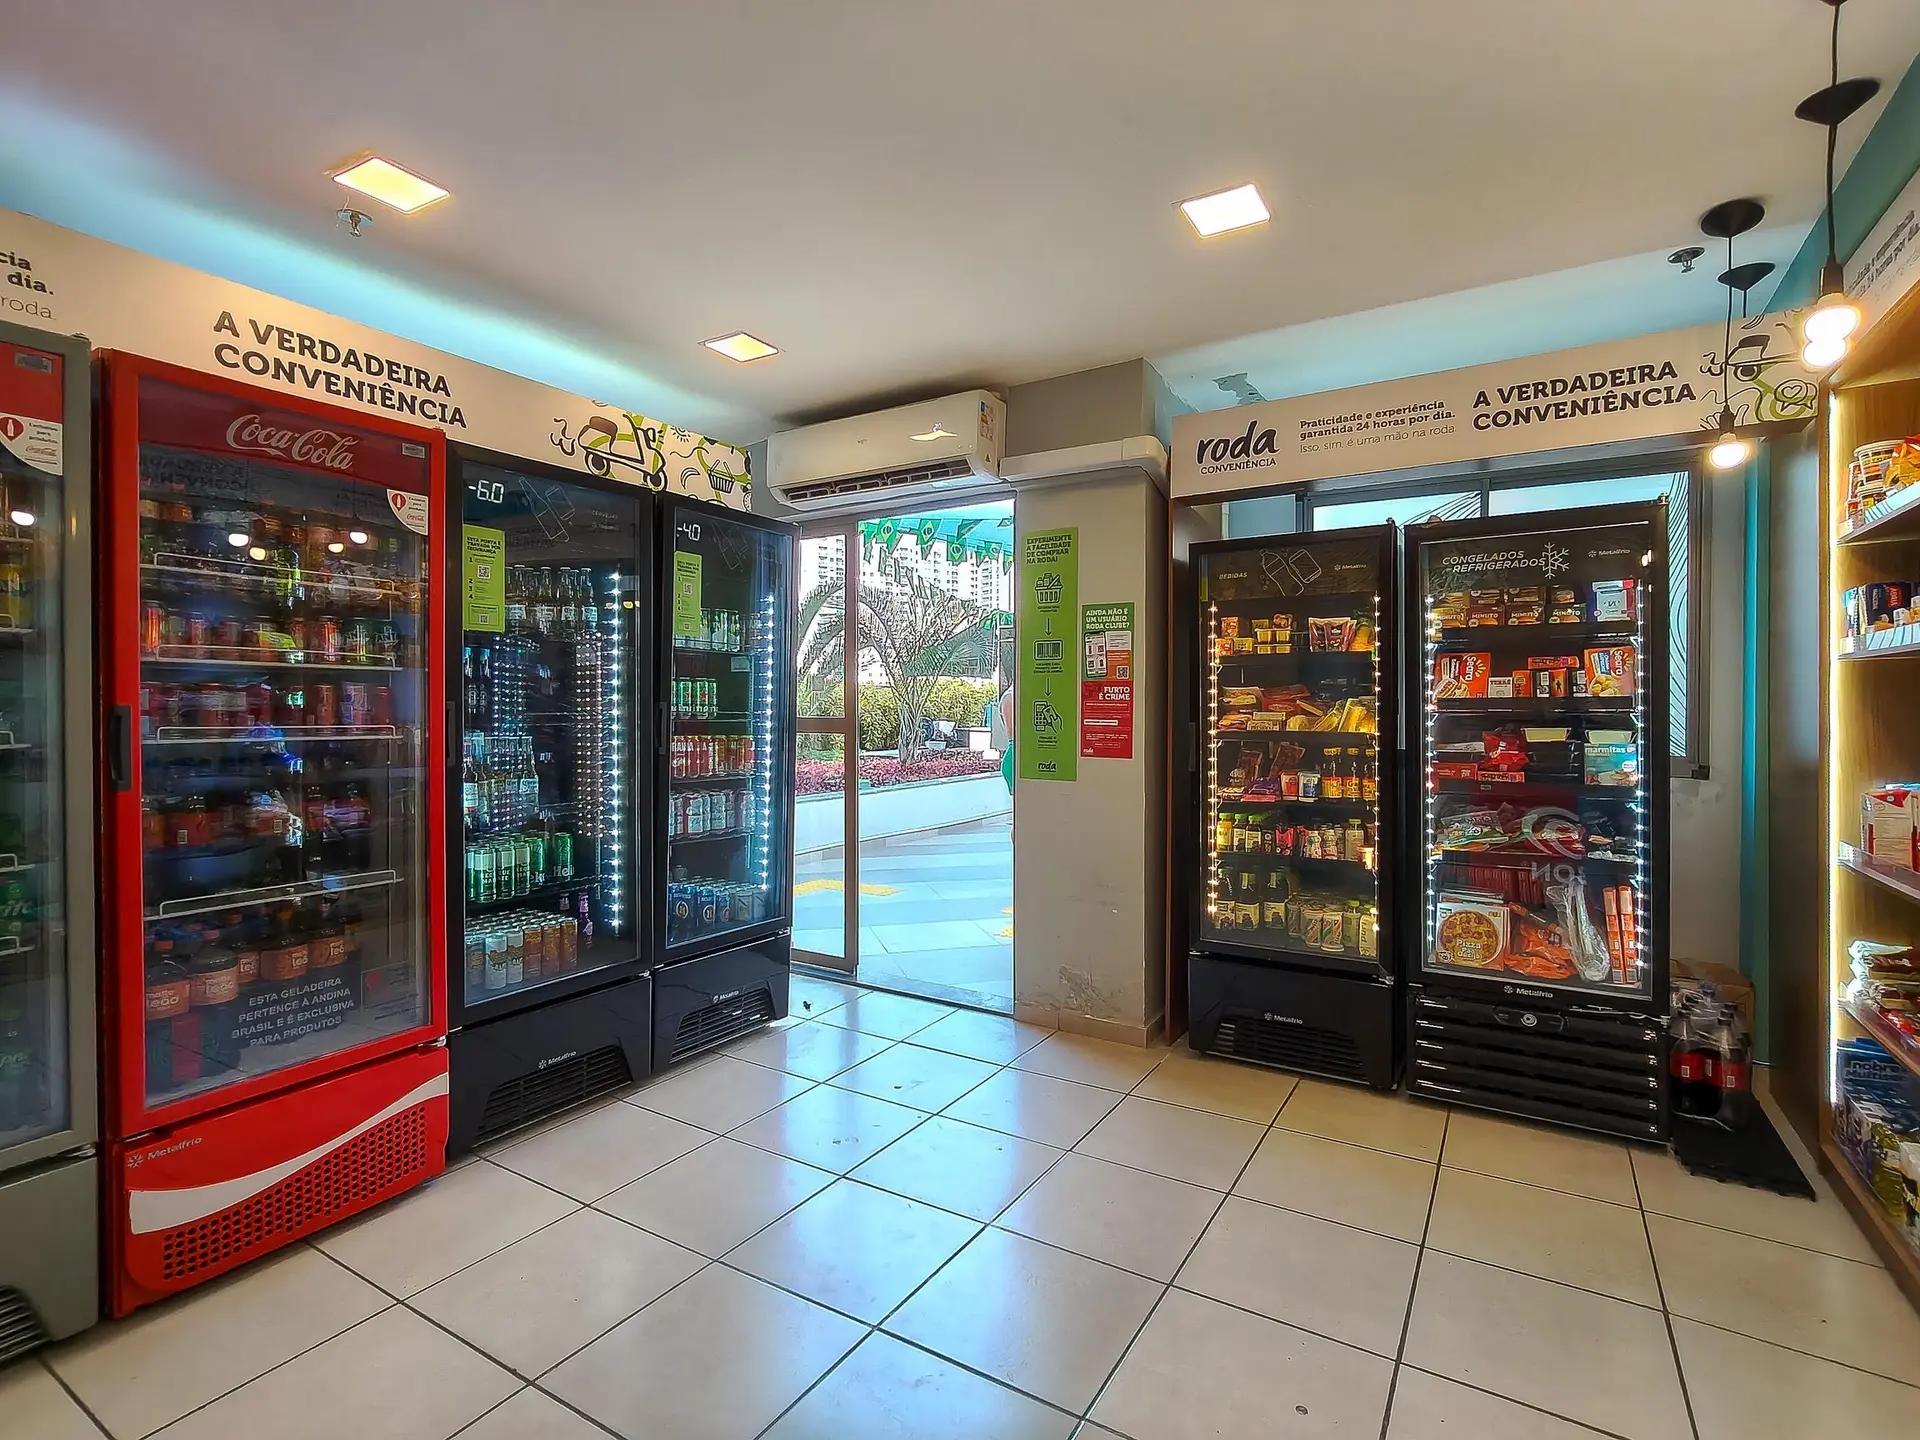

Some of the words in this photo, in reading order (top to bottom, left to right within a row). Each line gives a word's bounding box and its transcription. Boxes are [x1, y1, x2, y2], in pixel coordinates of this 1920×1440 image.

[7, 271, 54, 295] dia.
[214, 312, 239, 338] A
[249, 318, 451, 398] VERDADEIRA
[214, 344, 467, 429] CONVENIÊNCIA
[1473, 390, 1490, 409] A
[1497, 361, 1677, 406] VERDADEIRA
[1300, 412, 1363, 429] Praticidade
[1365, 412, 1373, 420] e
[1375, 400, 1445, 420] experiência
[1472, 383, 1697, 431] CONVENIÊNCIA
[1300, 424, 1354, 441] garantida
[1356, 421, 1370, 432] 24
[1372, 417, 1406, 430] horas
[1408, 415, 1432, 428] por
[1433, 409, 1457, 422] dia.
[226, 414, 358, 471] Coca-Cola
[1196, 420, 1280, 464] roda
[1323, 440, 1344, 452] sim,
[1347, 437, 1355, 447] é
[1356, 435, 1381, 446] uma
[1383, 430, 1410, 444] mão
[1412, 428, 1427, 439] na
[1429, 424, 1457, 438] roda.
[1200, 458, 1277, 475] CONVENIÊNCIA
[1027, 535, 1072, 547] EXPERIMENTE
[1036, 548, 1069, 558] COMPRAR
[1442, 550, 1524, 566] CONGELADOS
[1452, 557, 1546, 573] REFRIGERADOS
[1218, 571, 1248, 580] BEBIDAS
[1086, 609, 1105, 618] AINDA
[1106, 607, 1122, 616] NÃO
[1098, 614, 1127, 623] USUÁRIO
[1086, 623, 1104, 631] RODA
[1465, 656, 1477, 681] Seara
[1614, 650, 1623, 675] Seara
[1104, 686, 1130, 694] FURTO
[1105, 693, 1131, 701] CRIME
[1038, 760, 1057, 771] roda
[249, 993, 278, 1007] ESTA
[280, 978, 343, 1001] GELADEIRA
[1516, 987, 1554, 999] Metalfrio
[238, 1001, 299, 1023] PERTENCE
[311, 988, 352, 1008] ANDINA
[232, 1018, 275, 1039] BRASIL
[276, 1016, 285, 1028] E
[297, 1000, 354, 1023] EXCLUSIVA
[250, 1032, 282, 1047] PARA
[283, 1015, 343, 1041] PRODUTOS
[147, 1136, 203, 1161] Metalfrio
